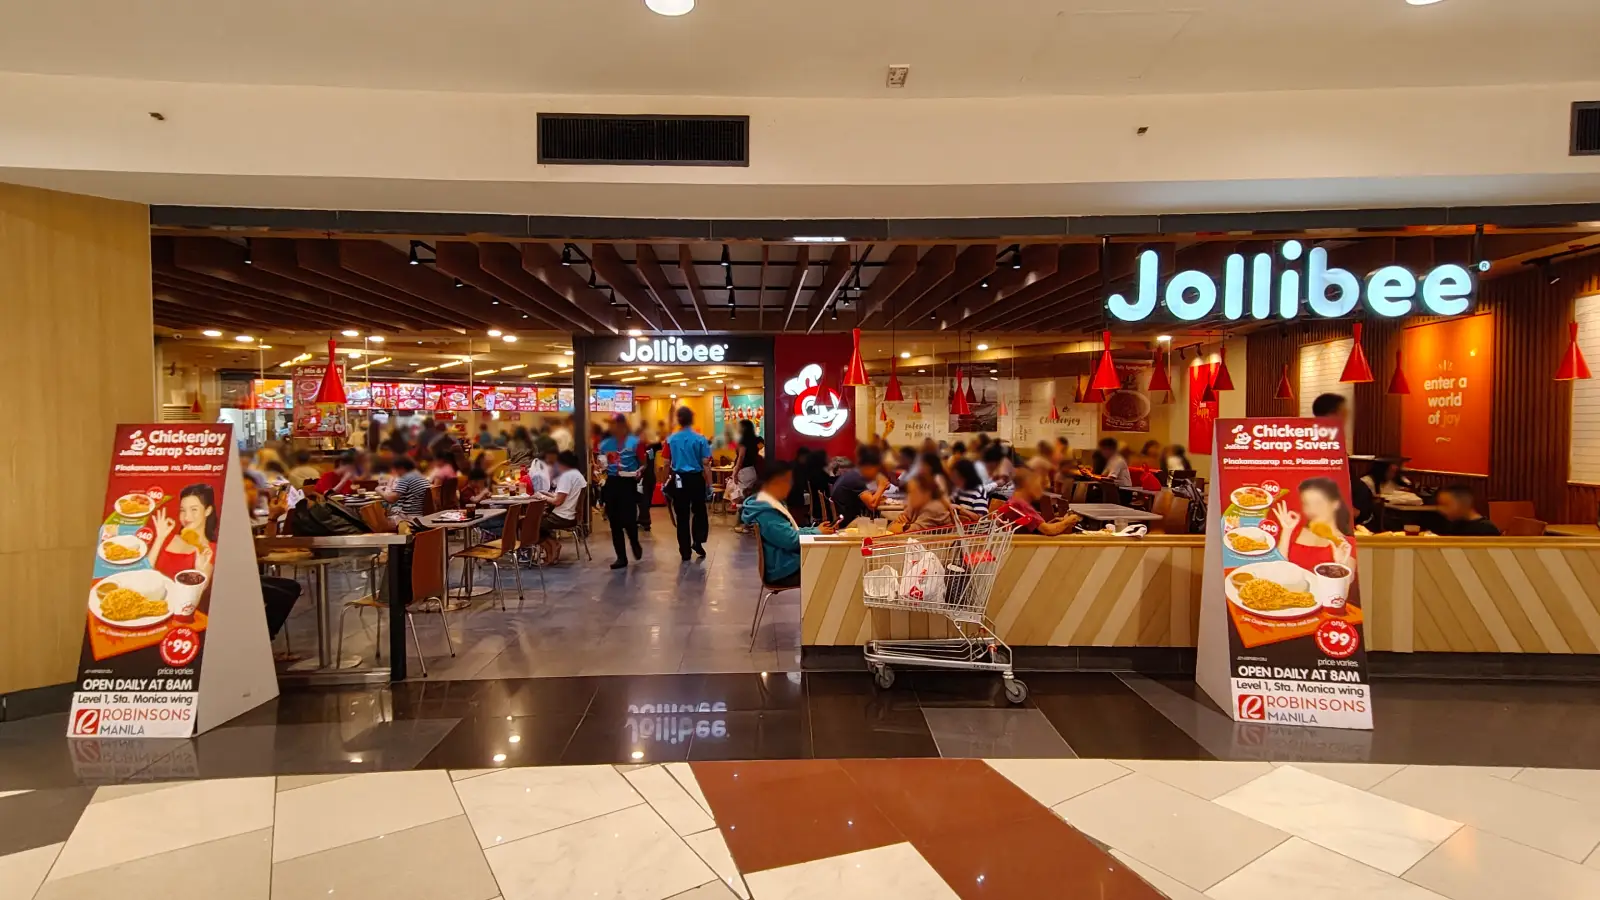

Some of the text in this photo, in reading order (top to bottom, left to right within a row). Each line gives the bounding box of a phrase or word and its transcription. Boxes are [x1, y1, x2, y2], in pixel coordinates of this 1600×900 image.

[1107, 239, 1472, 322] Jollibee
[620, 336, 725, 362] Jollibee
[1424, 376, 1468, 391] enter a
[1428, 392, 1463, 408] world
[1428, 410, 1460, 428] of joy
[149, 429, 227, 446] Chickenjoy
[1252, 424, 1339, 441] Chickenjoy
[147, 444, 224, 458] Sarap Savers
[1253, 439, 1340, 452] Sarap Savers
[1223, 458, 1280, 466] Pinakamasarap
[1330, 620, 1347, 630] only
[1317, 658, 1335, 667] price
[157, 667, 173, 676] price
[1238, 666, 1360, 682] OPEN DAILY AT 8AM
[83, 679, 192, 691] OPEN DAILY AT 8AM
[1237, 680, 1364, 698] Level 1, Sta. Monica wing
[78, 694, 193, 706] Level 1, Sta. Monica wing
[1266, 695, 1366, 713] ROBINSONS
[102, 708, 191, 721] ROBINSONS
[1268, 711, 1319, 724] MANILA
[100, 725, 145, 735] MANILA
